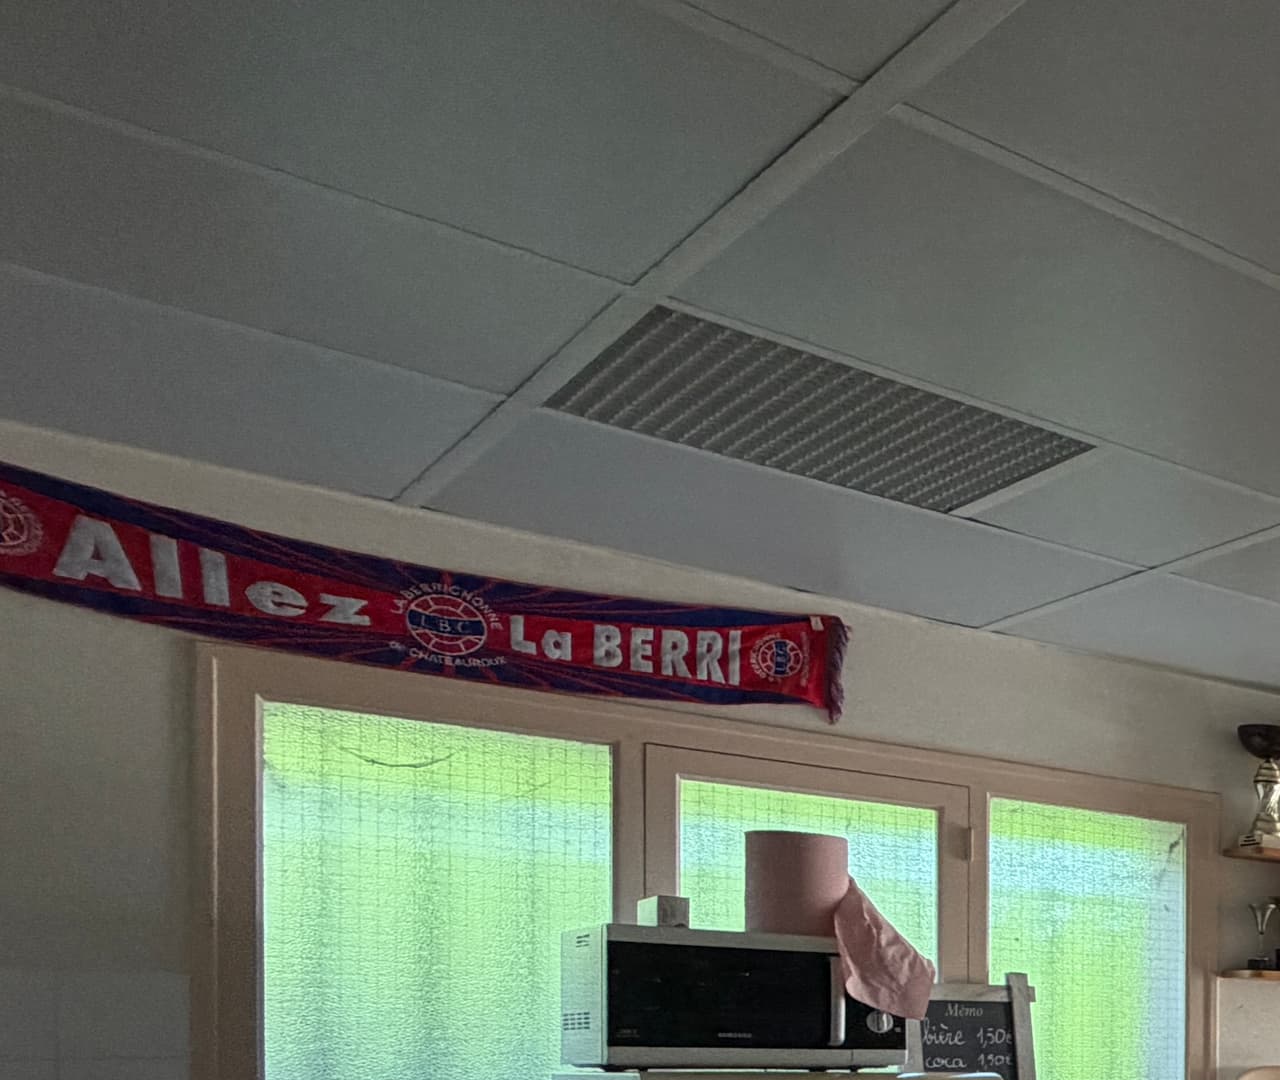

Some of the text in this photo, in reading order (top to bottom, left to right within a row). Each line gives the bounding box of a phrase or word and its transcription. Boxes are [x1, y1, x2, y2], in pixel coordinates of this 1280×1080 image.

[52, 514, 371, 626] Allez
[509, 614, 572, 661] La
[593, 624, 741, 687] BERRI
[923, 1017, 966, 1045] bière
[925, 1056, 967, 1068] coca
